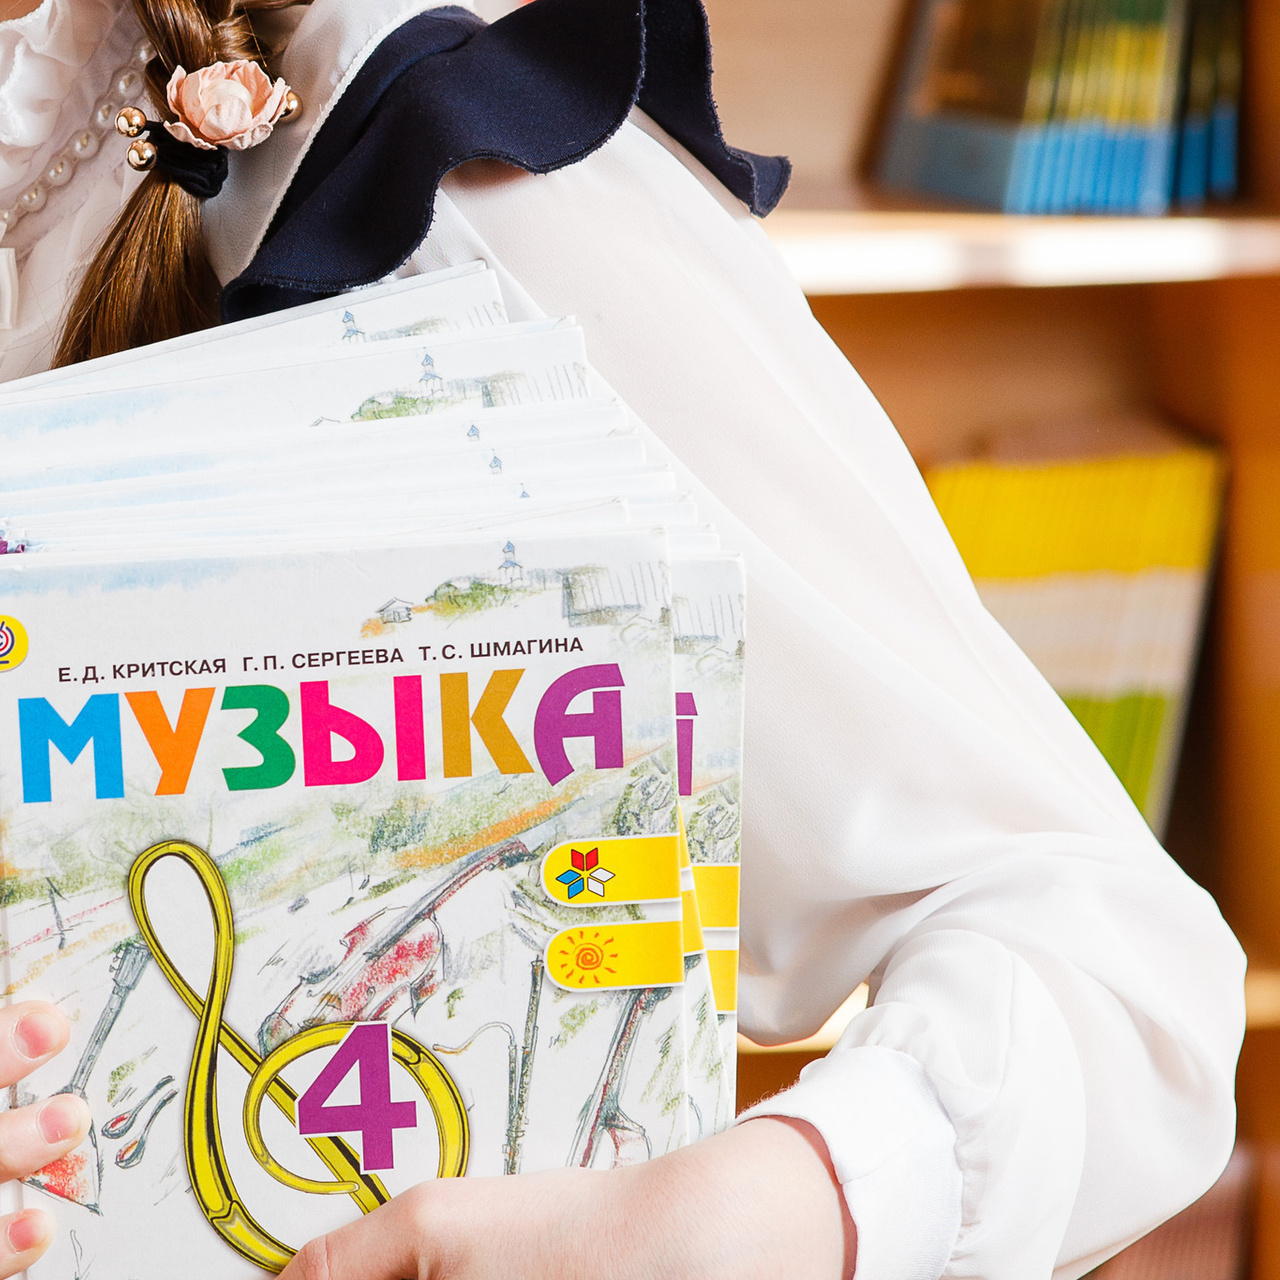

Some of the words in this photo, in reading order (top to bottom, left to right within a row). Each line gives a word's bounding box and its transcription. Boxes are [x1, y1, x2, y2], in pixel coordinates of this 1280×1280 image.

[112, 658, 227, 680] КРИТСКАЯ
[291, 648, 404, 669] СЕРГЕЕВА
[470, 637, 584, 658] ШМАГИНА
[18, 663, 626, 803] МУЗЫКА
[298, 1023, 417, 1171] 4
